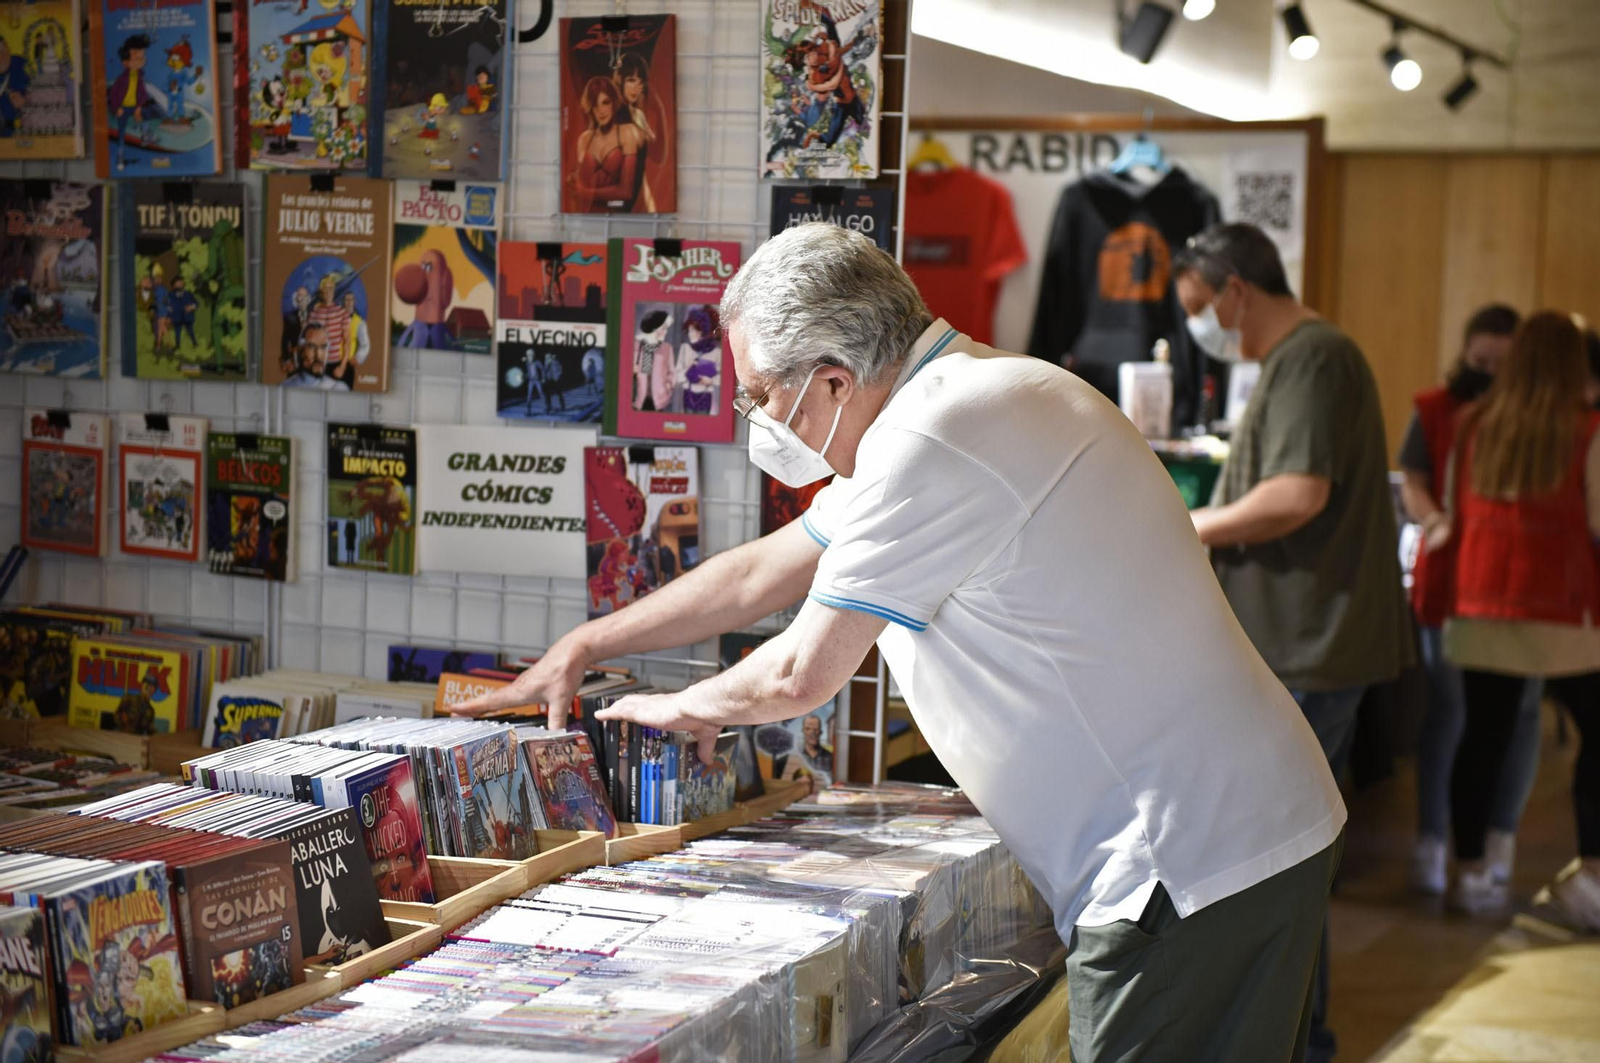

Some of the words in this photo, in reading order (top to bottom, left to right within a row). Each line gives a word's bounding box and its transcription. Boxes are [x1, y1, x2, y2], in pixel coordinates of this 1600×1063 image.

[138, 204, 166, 227] TIF
[277, 209, 321, 234] JULIO
[324, 211, 374, 236] VERNE
[401, 200, 461, 221] PACTO
[505, 328, 522, 344] EL
[529, 330, 597, 349] VECINO
[217, 459, 282, 486] BÉLICOS
[342, 456, 407, 478] IMPACTO
[447, 452, 566, 474] GRANDES
[460, 479, 553, 504] CÓMICS
[422, 510, 587, 533] INDEPENDIENTES
[78, 656, 172, 697] HULK
[221, 703, 283, 732] SUPERMAN
[372, 786, 391, 819] THE
[290, 826, 356, 865] ABALLERO
[369, 820, 407, 860] WICKED
[299, 853, 349, 890] LUNA
[88, 888, 167, 938] VENGADORES
[201, 885, 288, 930] CONAN
[282, 925, 292, 941] 15
